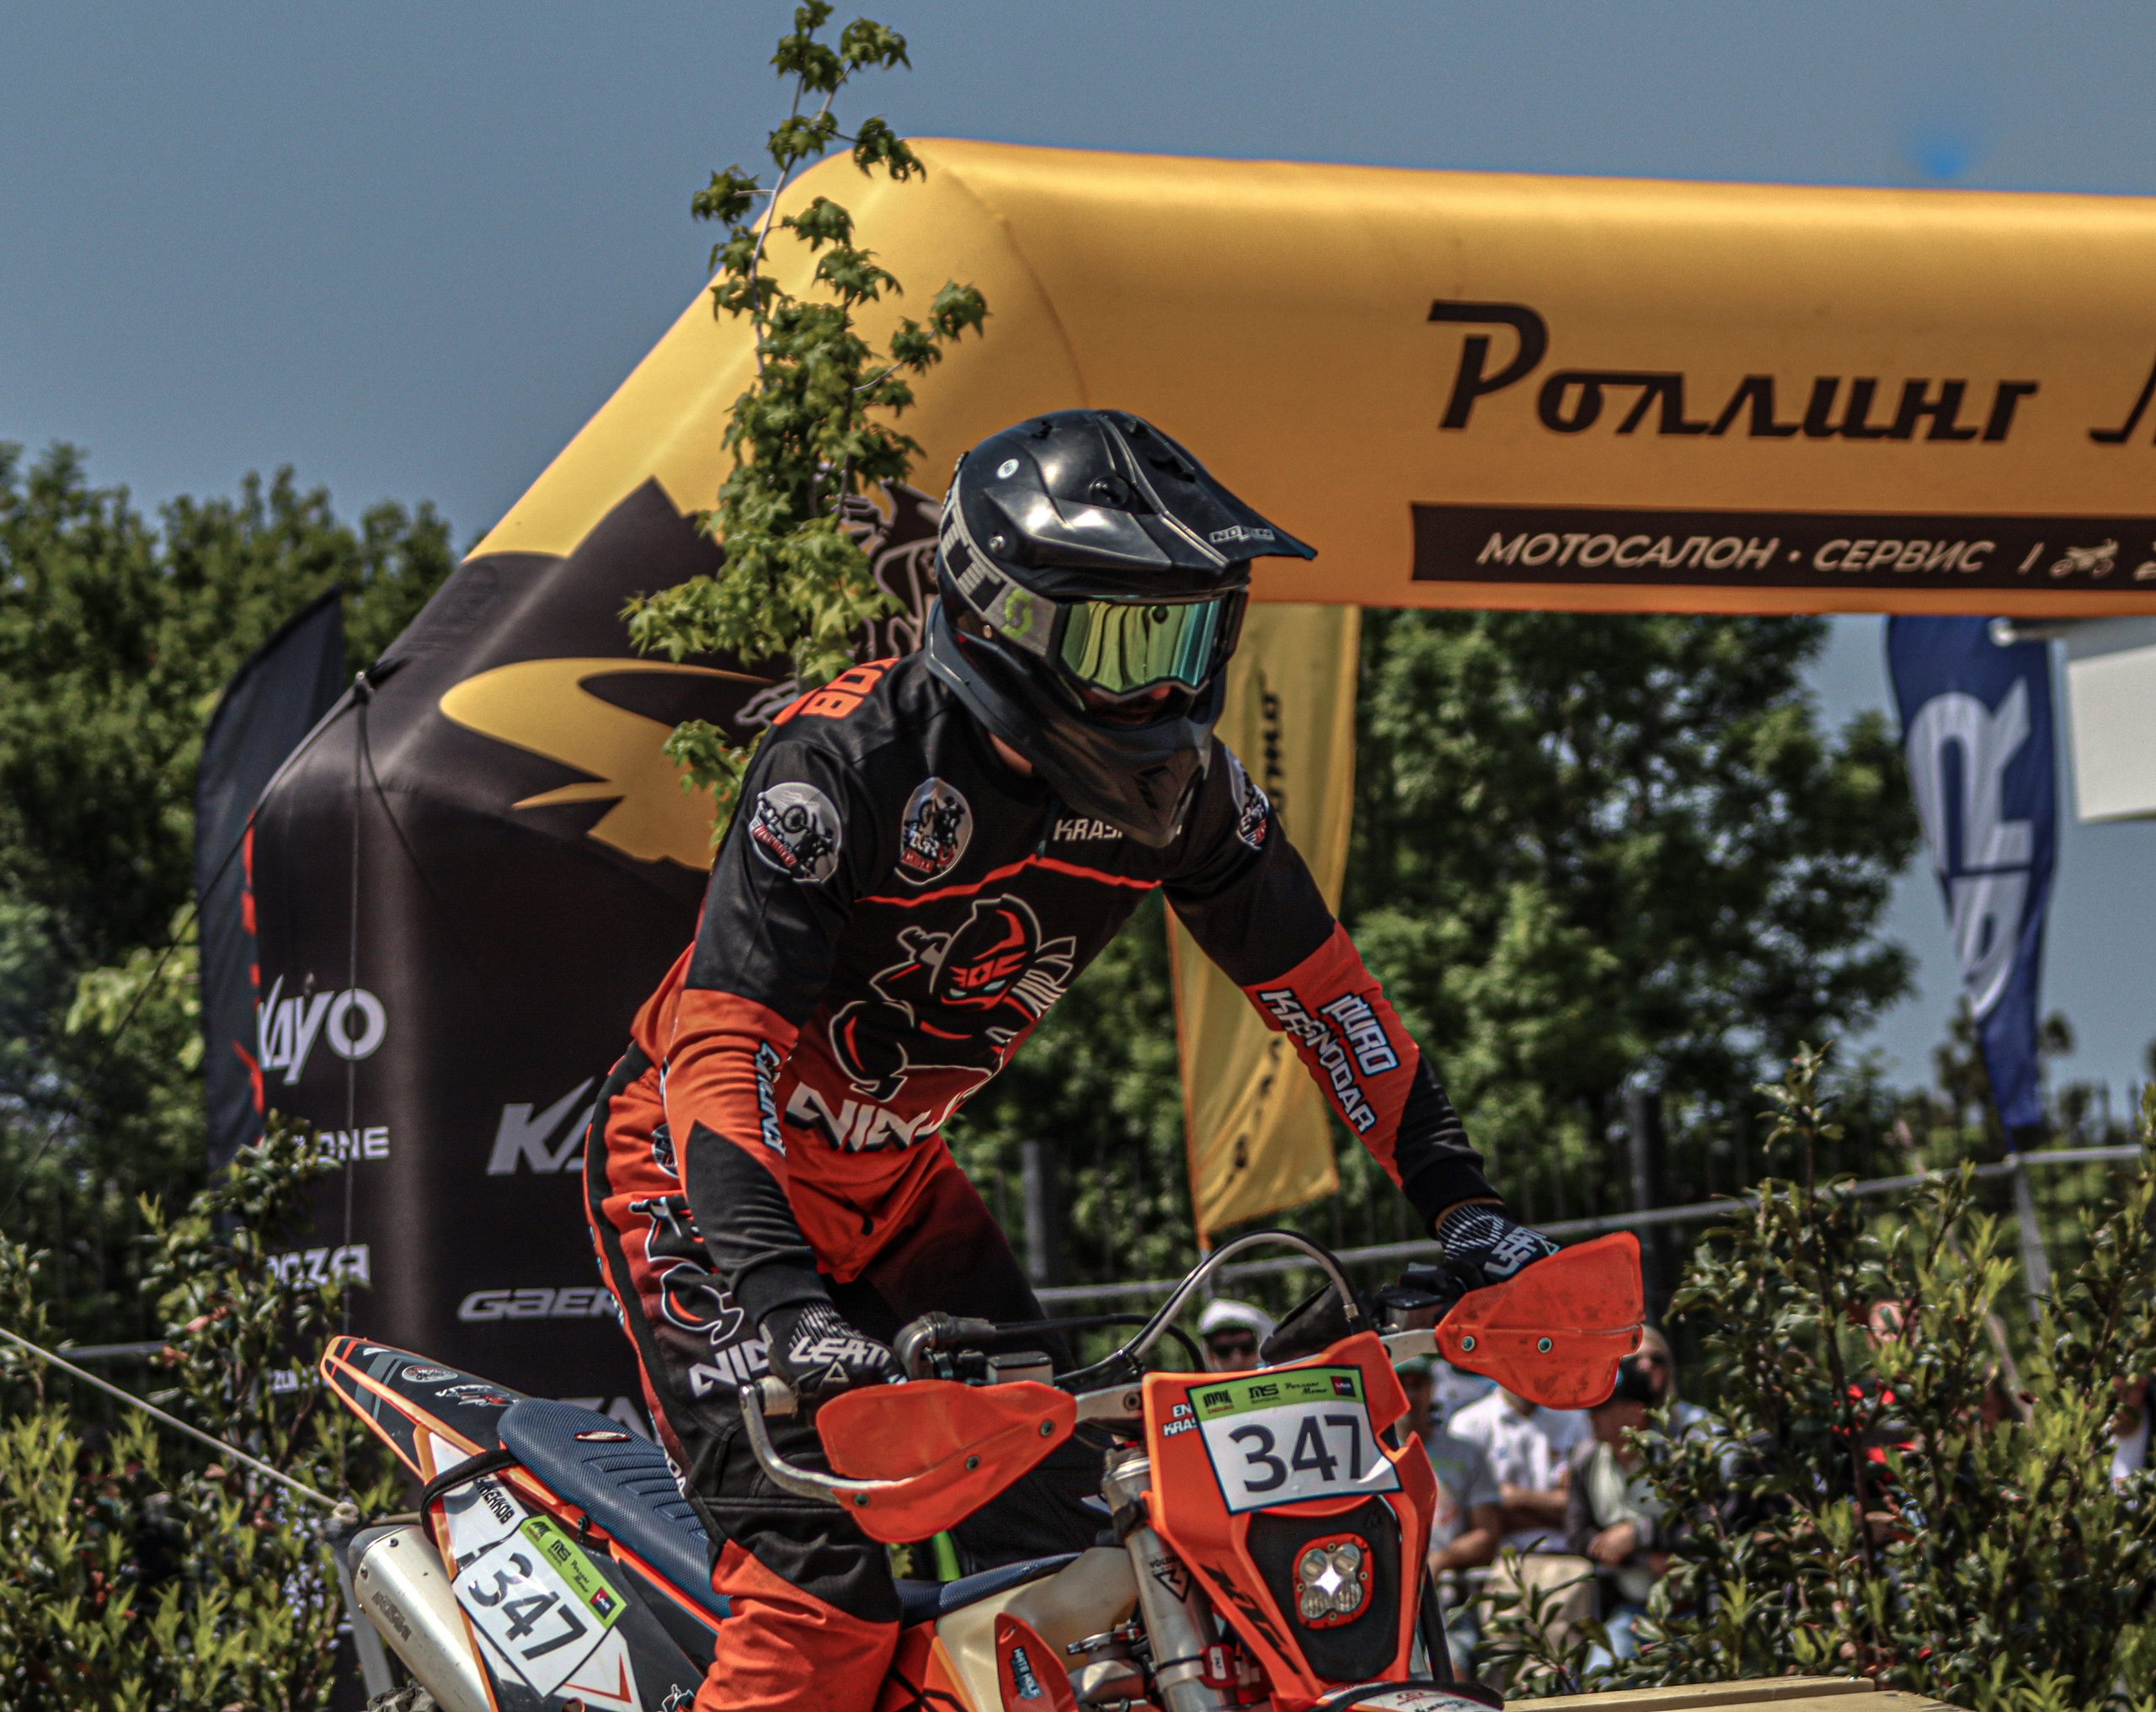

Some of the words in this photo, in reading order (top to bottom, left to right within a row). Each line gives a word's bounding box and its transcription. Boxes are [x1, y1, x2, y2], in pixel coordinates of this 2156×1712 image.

[1428, 299, 2040, 442] Роллинг
[1476, 532, 1780, 570] МОТОСАЛОН
[1812, 538, 1995, 573] СЕРВИС
[1228, 1415, 1363, 1492] 347
[468, 1552, 588, 1661] 347
